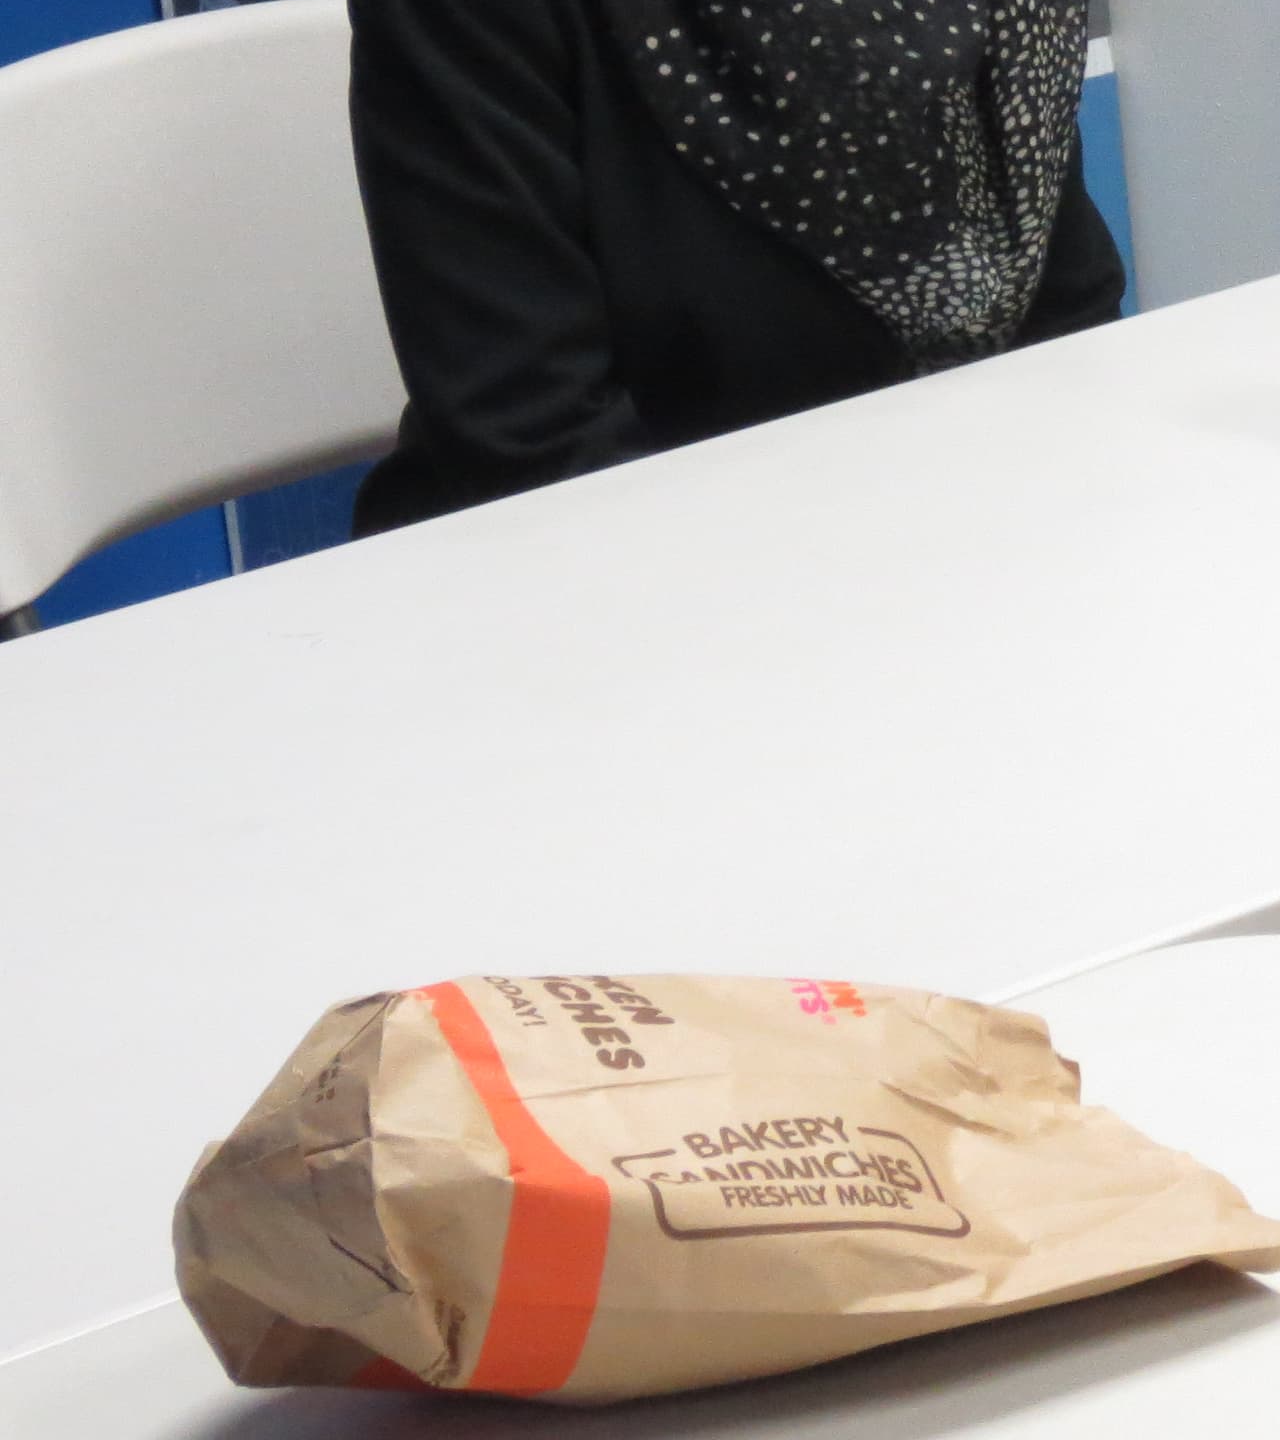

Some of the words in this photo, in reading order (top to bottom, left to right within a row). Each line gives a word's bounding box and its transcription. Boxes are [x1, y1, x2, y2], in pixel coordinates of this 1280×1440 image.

[681, 1115, 850, 1160] BAKERY
[719, 1184, 826, 1210] FRESHLY
[836, 1183, 914, 1211] MADE
